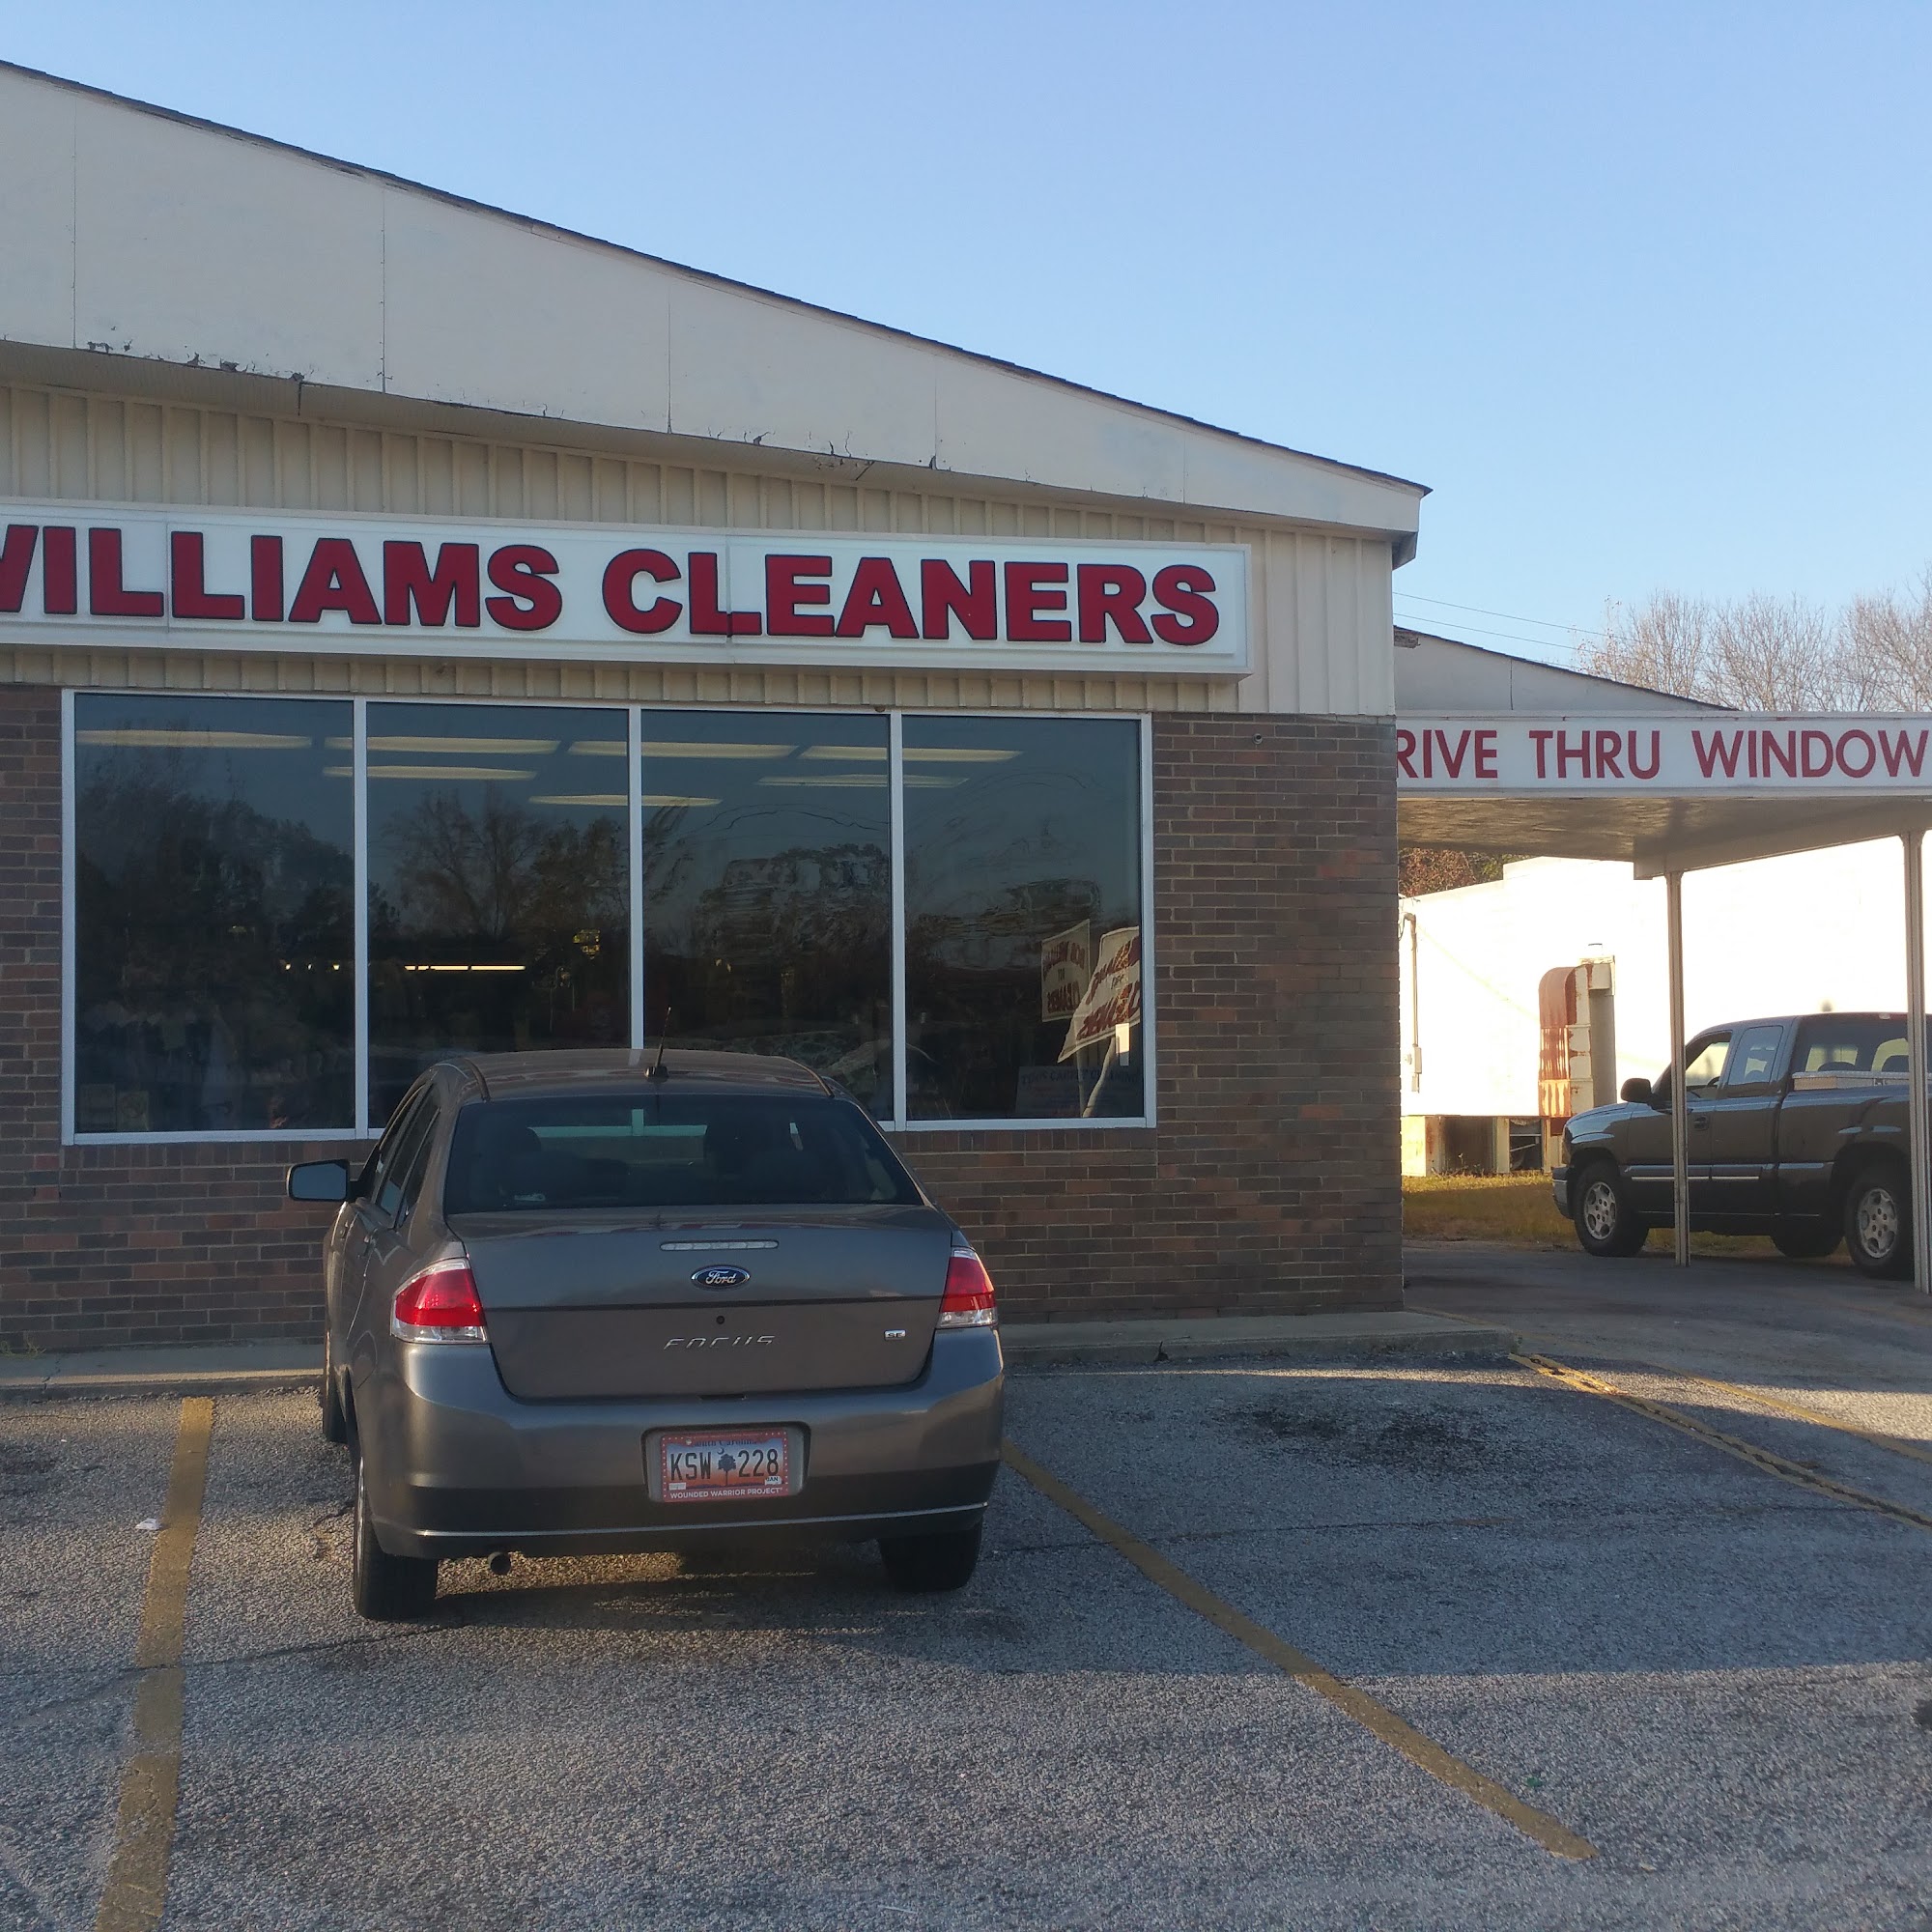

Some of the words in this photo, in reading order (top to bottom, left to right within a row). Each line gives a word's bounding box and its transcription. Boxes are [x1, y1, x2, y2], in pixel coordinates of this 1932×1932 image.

[601, 548, 1220, 646] CLEANERS
[1528, 729, 1661, 780] THRU
[1691, 728, 1929, 780] WINDOW
[705, 1270, 737, 1285] Ford
[664, 1335, 776, 1350] FOCUS
[670, 1452, 712, 1481] KSW
[737, 1448, 780, 1477] 228
[669, 1491, 709, 1499] WOUNDED
[710, 1489, 746, 1497] WARRIOR
[747, 1487, 780, 1495] PROJECT
